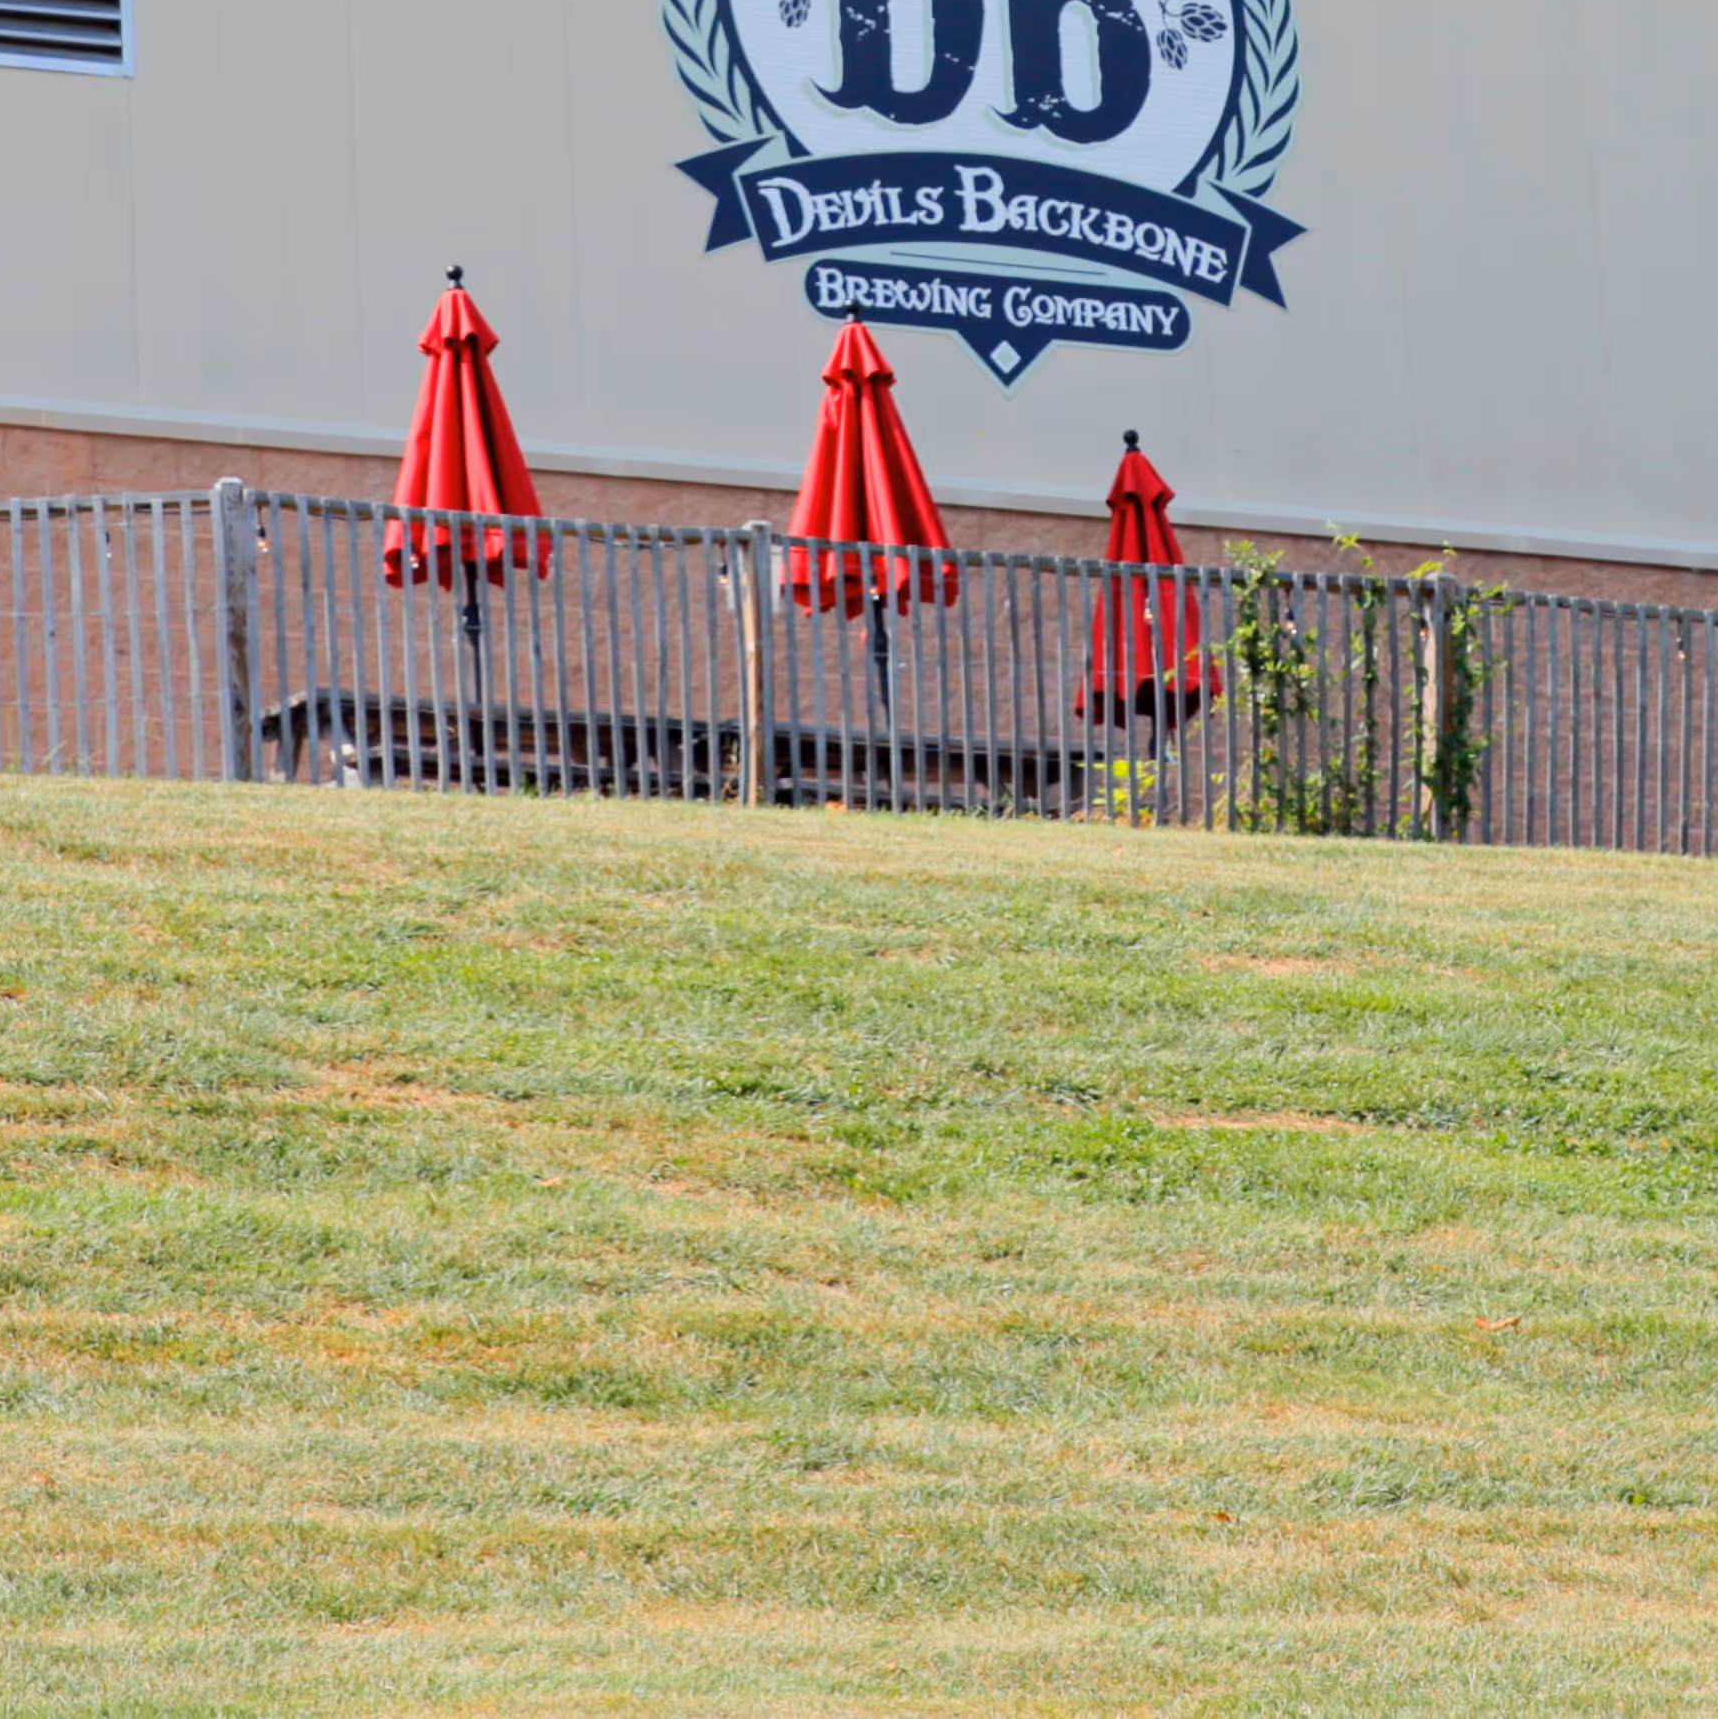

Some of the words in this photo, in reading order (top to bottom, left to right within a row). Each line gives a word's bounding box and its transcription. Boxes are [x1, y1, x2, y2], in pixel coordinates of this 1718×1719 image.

[757, 177, 945, 248] DEVILS
[954, 164, 1228, 283] BACKBONE
[815, 267, 992, 319] BREWING
[1003, 286, 1180, 335] COMPANY
